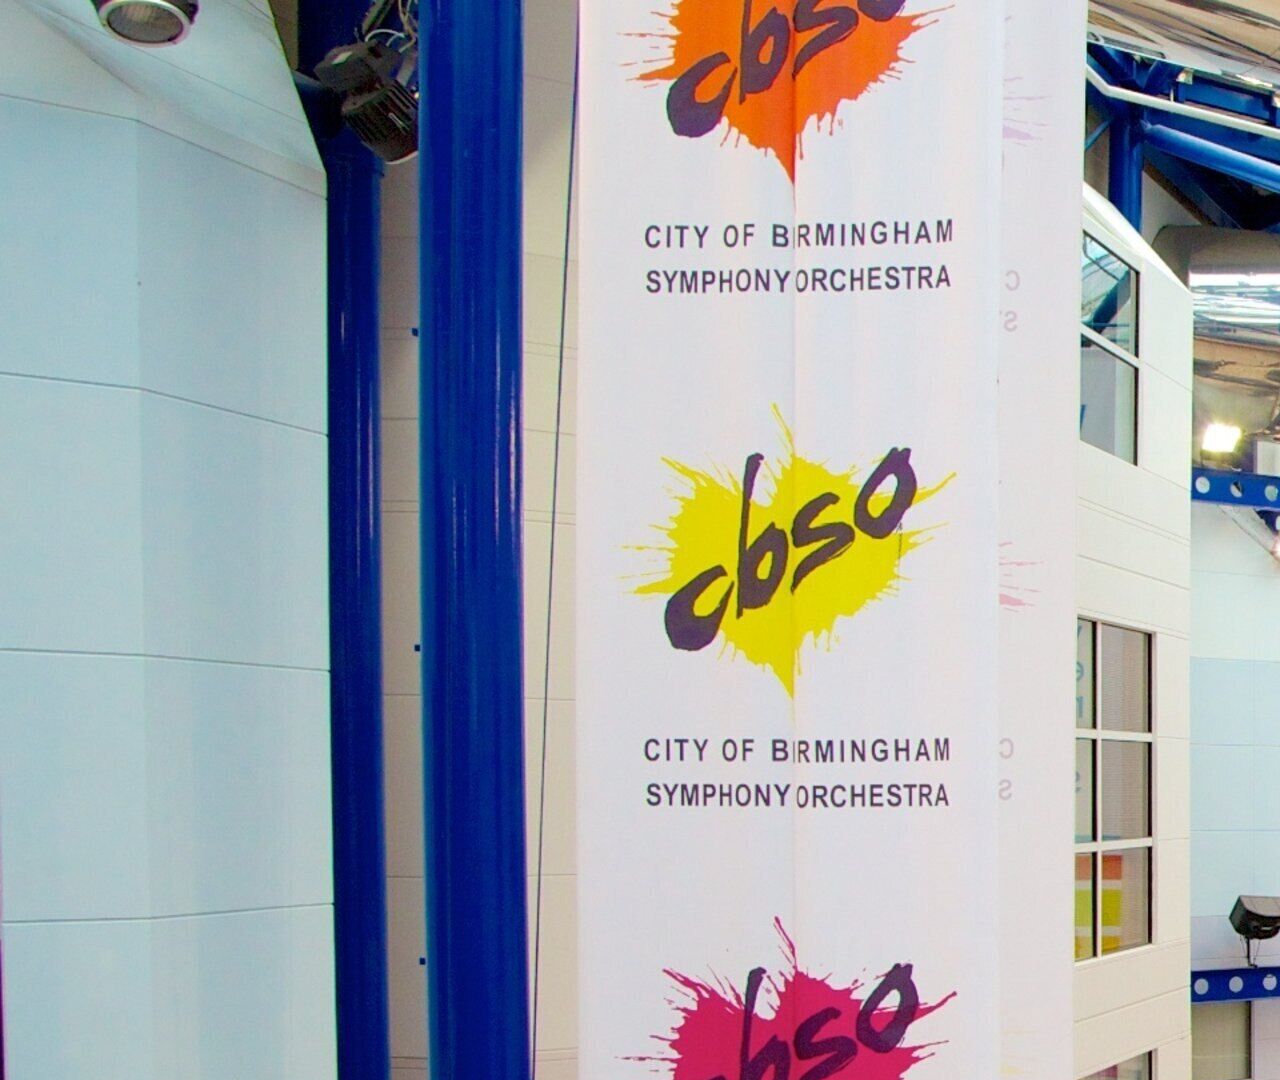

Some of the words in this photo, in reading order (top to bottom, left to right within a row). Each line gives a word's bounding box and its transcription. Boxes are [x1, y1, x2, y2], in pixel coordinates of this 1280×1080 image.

[667, 0, 904, 137] cbs
[645, 225, 708, 248] CITY
[724, 224, 754, 247] OF
[773, 219, 952, 247] BIRMINGHAM
[647, 269, 790, 293] SYMPHONY
[796, 265, 950, 292] ORCHESTRA
[664, 447, 918, 651] cbso
[645, 739, 708, 761] CITY
[723, 739, 754, 761] OF
[772, 738, 949, 762] BIRMINGHAM
[647, 784, 790, 806] SYMPHONY
[797, 784, 948, 808] ORCHESTRA
